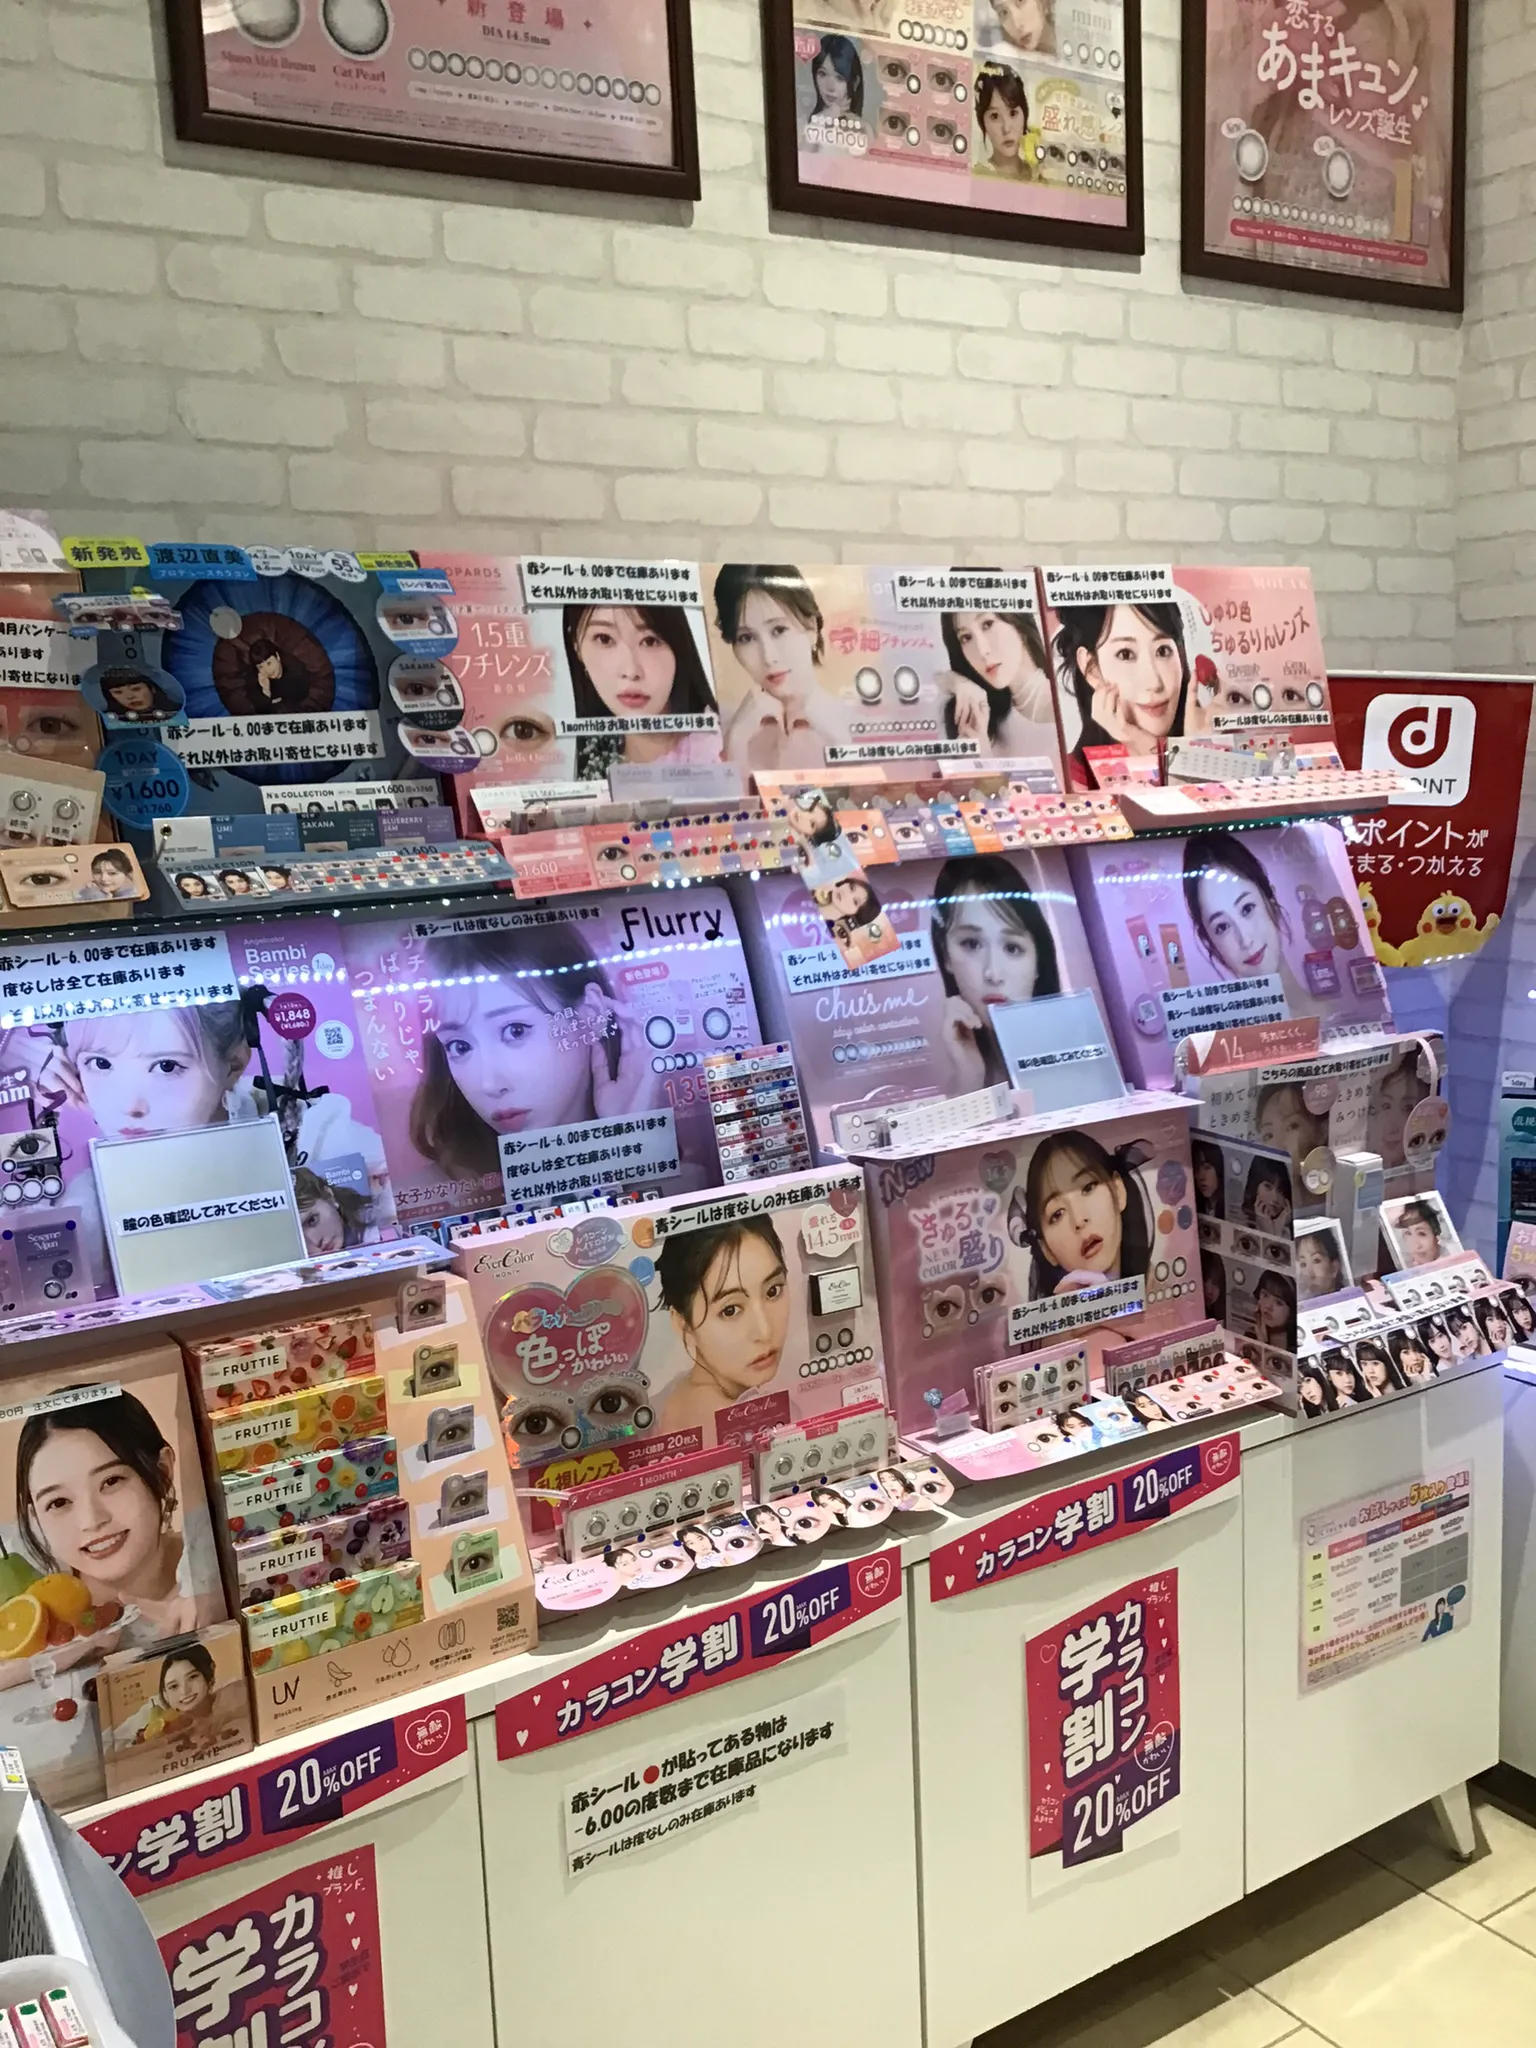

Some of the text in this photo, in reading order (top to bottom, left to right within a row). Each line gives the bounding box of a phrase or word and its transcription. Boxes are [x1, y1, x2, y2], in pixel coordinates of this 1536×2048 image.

[1258, 22, 1418, 109] あまキュン
[1329, 104, 1412, 145] レンズ誕生
[70, 545, 142, 562] 新発売
[156, 548, 246, 566] 渡辺直美
[471, 621, 527, 648] 1.5重
[1210, 605, 1311, 656] ちゅるりんレンズ
[452, 652, 552, 680] フチレンズ
[302, 820, 335, 829] SAKANA
[382, 817, 423, 826] BLUEBERRY
[620, 906, 724, 953] Flurry
[245, 944, 307, 965] Bambi
[922, 1260, 957, 1279] COLOR
[223, 1354, 280, 1378] FRUTTIE
[571, 1352, 629, 1377] かわいい
[235, 1416, 293, 1440] FRUTTIE
[246, 1482, 303, 1507] FRUTTIE
[976, 1482, 1115, 1579] カラコン学割
[260, 1547, 317, 1572] FRUTTIE
[272, 1611, 330, 1638] FRUTTIE
[557, 1616, 738, 1735] カラコン学割
[1115, 1600, 1147, 1753] カラコン
[1060, 1615, 1114, 1779] 学割
[570, 1714, 788, 1815] 赤シール が貼ってある物は
[572, 1784, 757, 1873] 青シールは度なしのみ在庫あります
